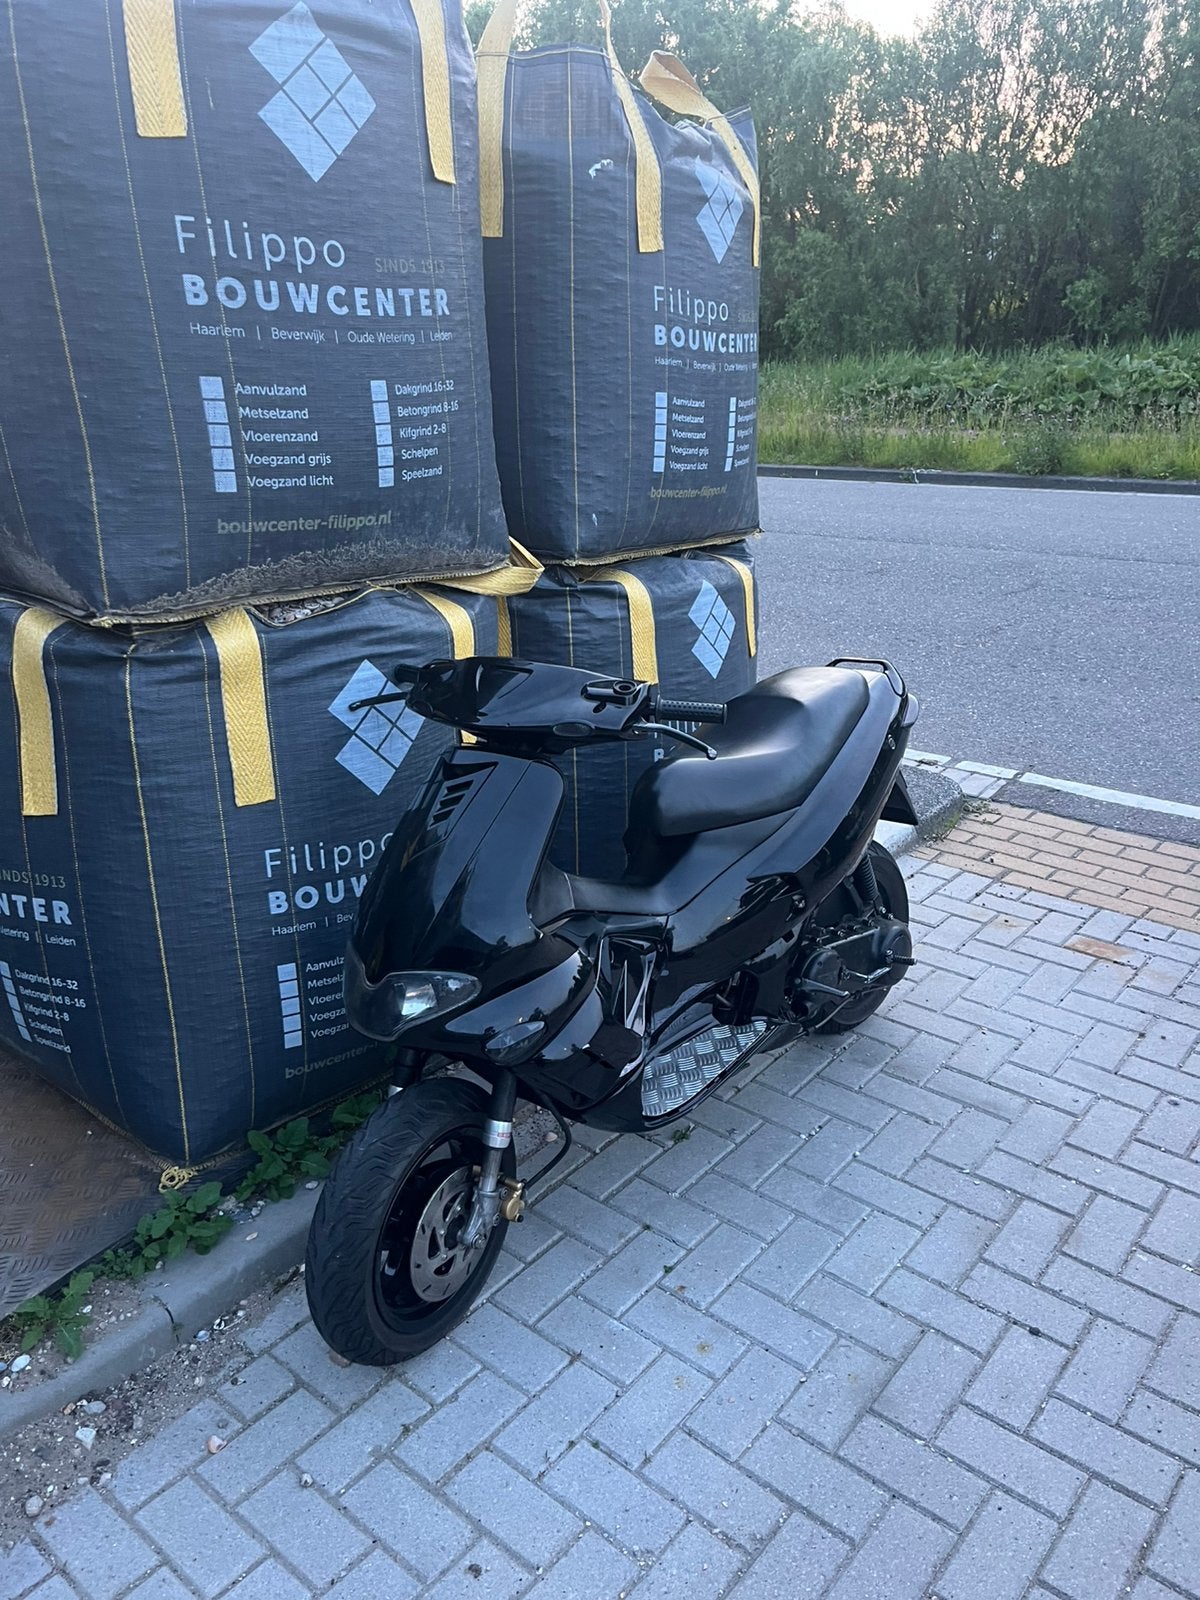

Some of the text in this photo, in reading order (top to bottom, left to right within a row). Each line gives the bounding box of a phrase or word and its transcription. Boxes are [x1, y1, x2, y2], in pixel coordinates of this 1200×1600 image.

[174, 215, 346, 273] Filippo
[374, 257, 417, 273] SINDS
[182, 274, 450, 316] BOUWCENTER
[653, 285, 729, 326] Filippo
[189, 322, 453, 345] Haarlem Beverwijk Oude Wetering Leiden
[655, 355, 683, 367] Haarlem
[235, 382, 307, 396] Aanvulzand
[395, 379, 455, 396] Dakgrind 16-32
[397, 400, 459, 417] Betongrind 8-16
[672, 396, 705, 408] Aanvulzand
[239, 406, 309, 419] Metselzand
[672, 412, 704, 424] Metselzand
[241, 430, 318, 442] Vloerenzand
[400, 422, 447, 439] Kifgrind 2-8
[671, 429, 706, 439] Vloerenzand
[401, 447, 439, 460] Schelpen
[670, 444, 699, 456] Voegzand
[244, 453, 332, 467] Voegzand grijs
[669, 460, 697, 472] Voegzand
[401, 465, 443, 482] Speelzand
[246, 475, 334, 489] Voegzand licht
[217, 510, 393, 535] bouwcenter-filippo.nl
[34, 873, 66, 889] 1913
[271, 921, 317, 936] Haarlem
[45, 933, 77, 947] Leiden
[305, 956, 345, 973] Aanvulz
[14, 968, 79, 991] Dakgrind 16-32
[64, 995, 87, 1009] 8-16
[53, 1009, 70, 1022] 2-8
